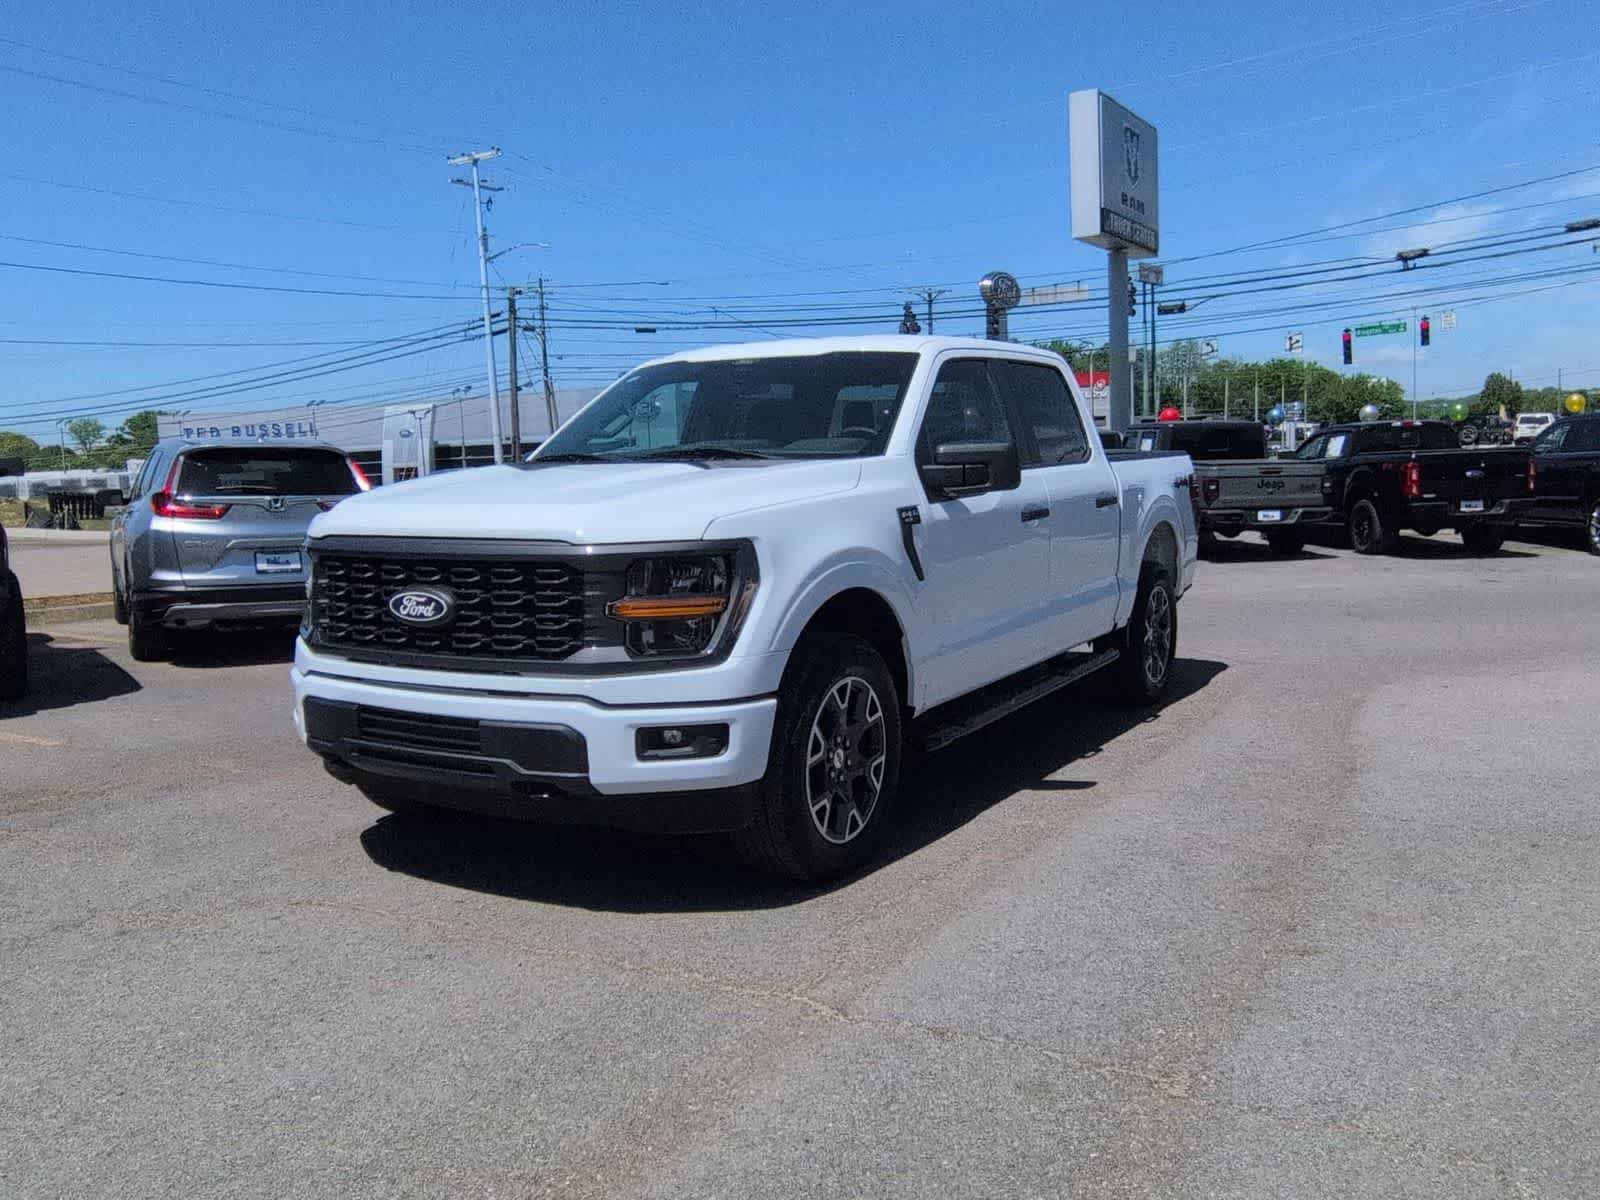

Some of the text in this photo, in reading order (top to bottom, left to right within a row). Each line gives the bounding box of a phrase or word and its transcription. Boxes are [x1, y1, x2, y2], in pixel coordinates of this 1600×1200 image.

[1121, 192, 1145, 215] RAM
[1257, 479, 1285, 490] Jeep
[399, 595, 437, 617] Ford
